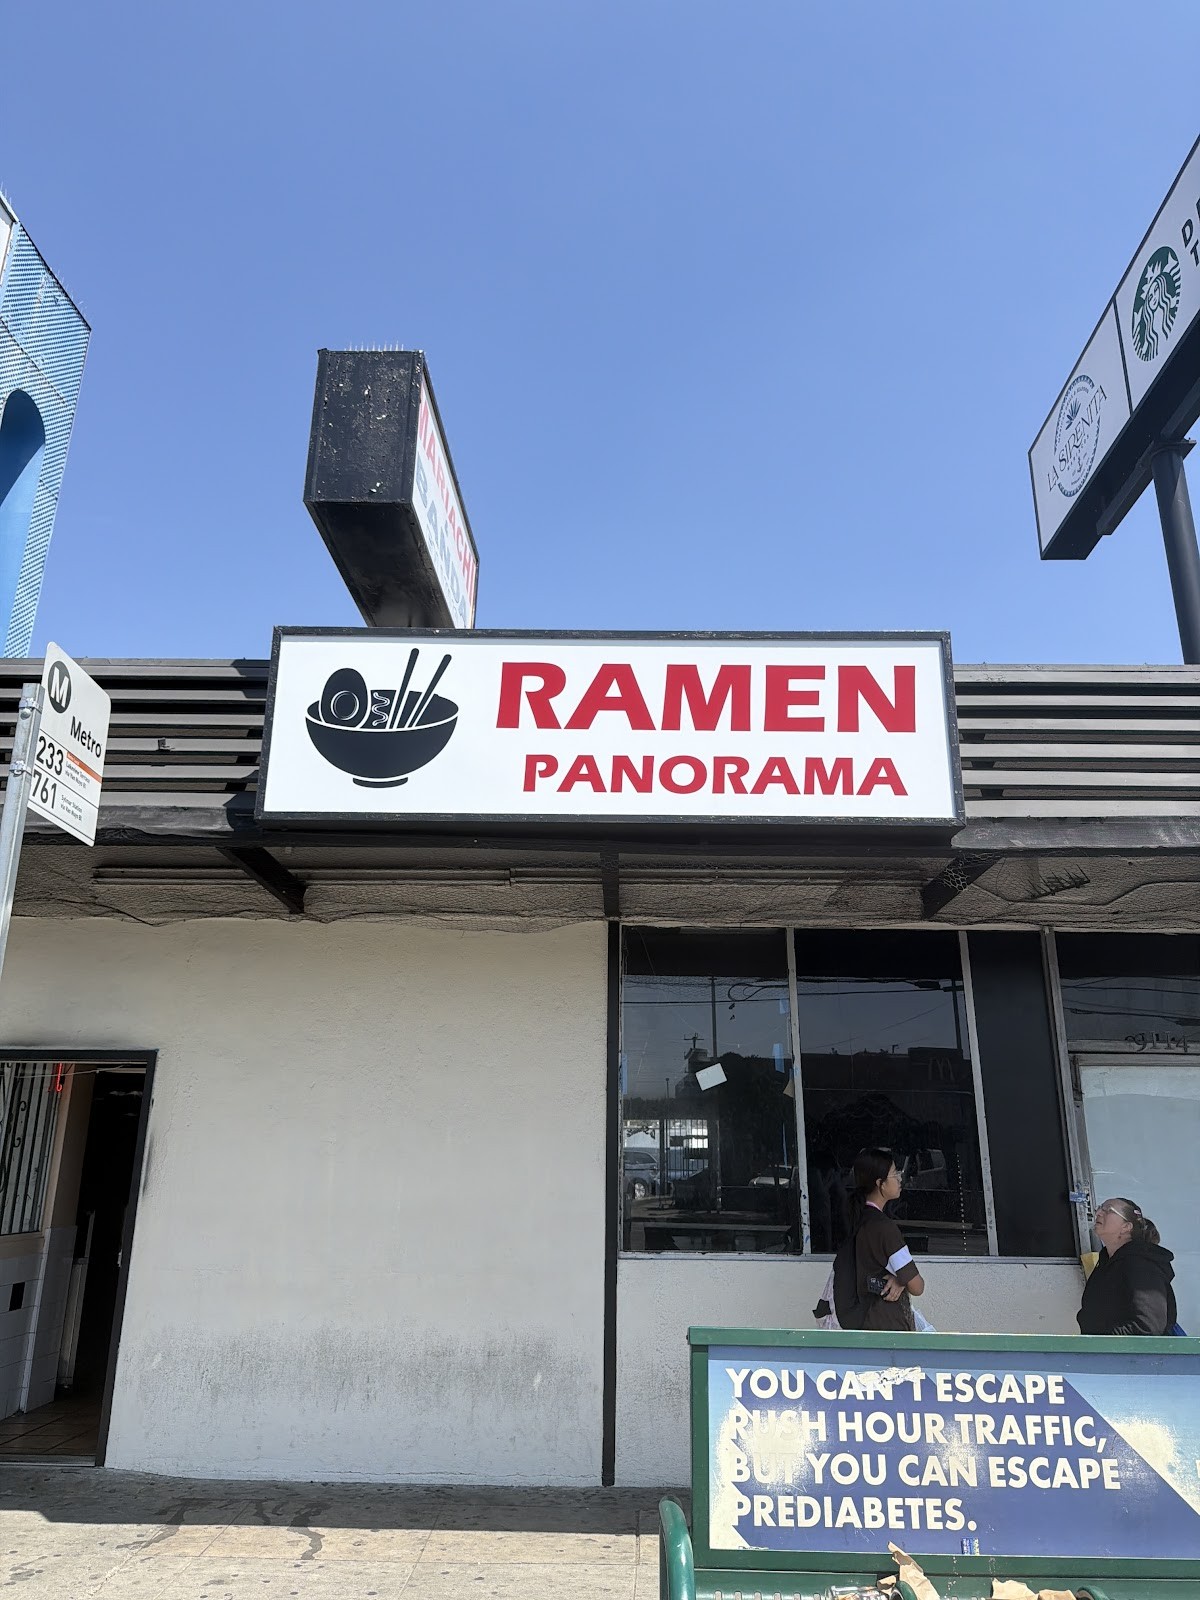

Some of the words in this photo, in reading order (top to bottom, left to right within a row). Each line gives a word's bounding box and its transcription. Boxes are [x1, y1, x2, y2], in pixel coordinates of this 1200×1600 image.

[1047, 465, 1059, 492] LA
[1059, 385, 1107, 471] SIRENITA
[50, 666, 69, 708] M
[496, 662, 916, 733] RAMEN
[36, 735, 64, 775] 233
[70, 715, 101, 758] Metro
[32, 769, 57, 809] 761
[523, 754, 909, 796] PANORAMA
[726, 1368, 805, 1399] YOU
[936, 1372, 1065, 1404] ESCAPE
[728, 1409, 827, 1441] RUSH
[838, 1411, 949, 1444] HOUR
[954, 1413, 1107, 1453] TRAFFIC,
[731, 1451, 800, 1484] BUT
[805, 1452, 887, 1486] YOU
[898, 1454, 978, 1487] CAN
[988, 1456, 1121, 1489] ESCAPE
[732, 1494, 977, 1531] PREDIABETES.
